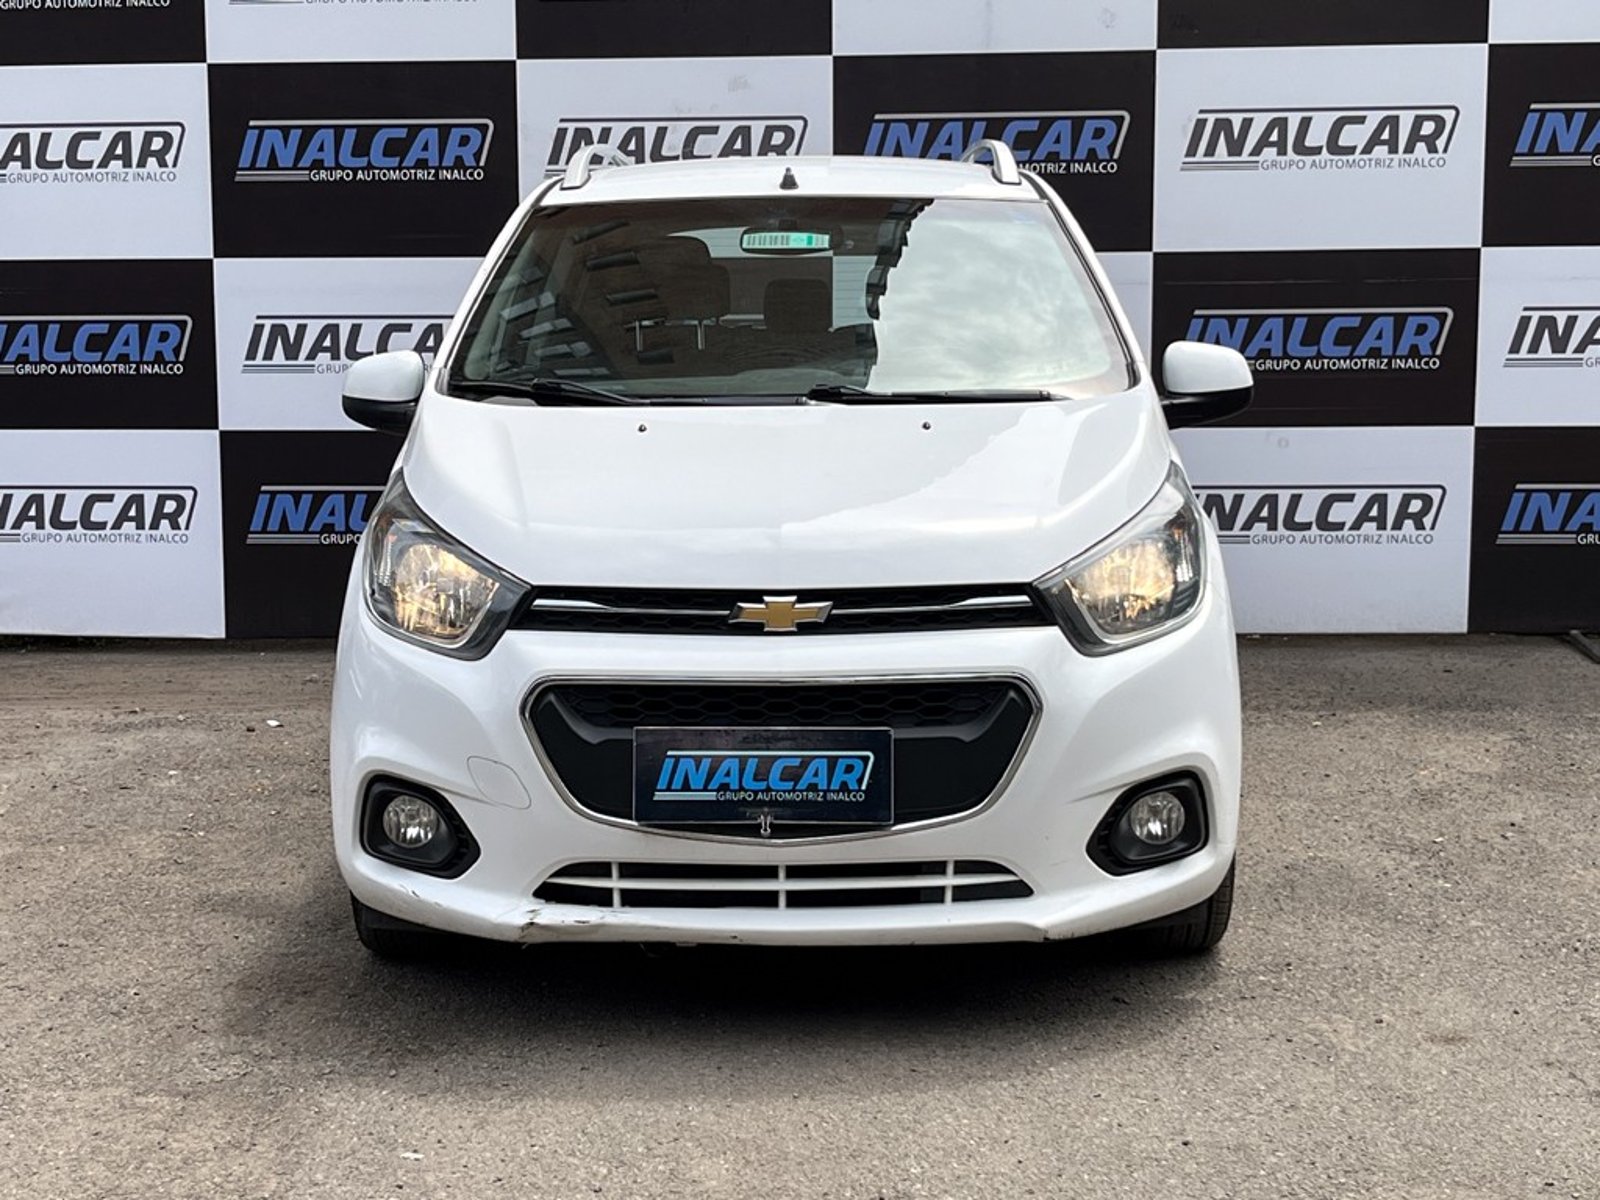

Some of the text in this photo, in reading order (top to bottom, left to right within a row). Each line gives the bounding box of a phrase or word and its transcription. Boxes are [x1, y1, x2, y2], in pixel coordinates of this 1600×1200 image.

[1184, 115, 1446, 158] INALCAR
[0, 131, 174, 170] ALCAR
[238, 127, 482, 168] INALCAR
[1070, 161, 1118, 173] INALCO
[1260, 157, 1447, 171] GRUPO AUTOMOTRIZ INALCO
[7, 171, 177, 184] GRUPO AUTOMOTRIZ INALCO
[310, 168, 484, 182] GRUPO AUTOMOTRIZ INALCO
[245, 323, 444, 361] INALCA
[1185, 316, 1440, 357] INALCAR
[15, 363, 184, 375] GRUPO AUTOMOTRIZ INALCO
[316, 364, 352, 374] GRUP
[1255, 358, 1440, 371] GRUPO AUTOMOTRIZ INALCO
[250, 493, 368, 532] INAL
[1195, 493, 1434, 531] NALCAR
[21, 532, 189, 543] GRUPO AUTOMOTRIZ INALCO
[1251, 534, 1434, 545] GRUPO AUTOMOTRIZ INALCO
[656, 757, 864, 790] INALCAR
[717, 791, 865, 802] GRUPO AUTOMOTRIZ INALCO
